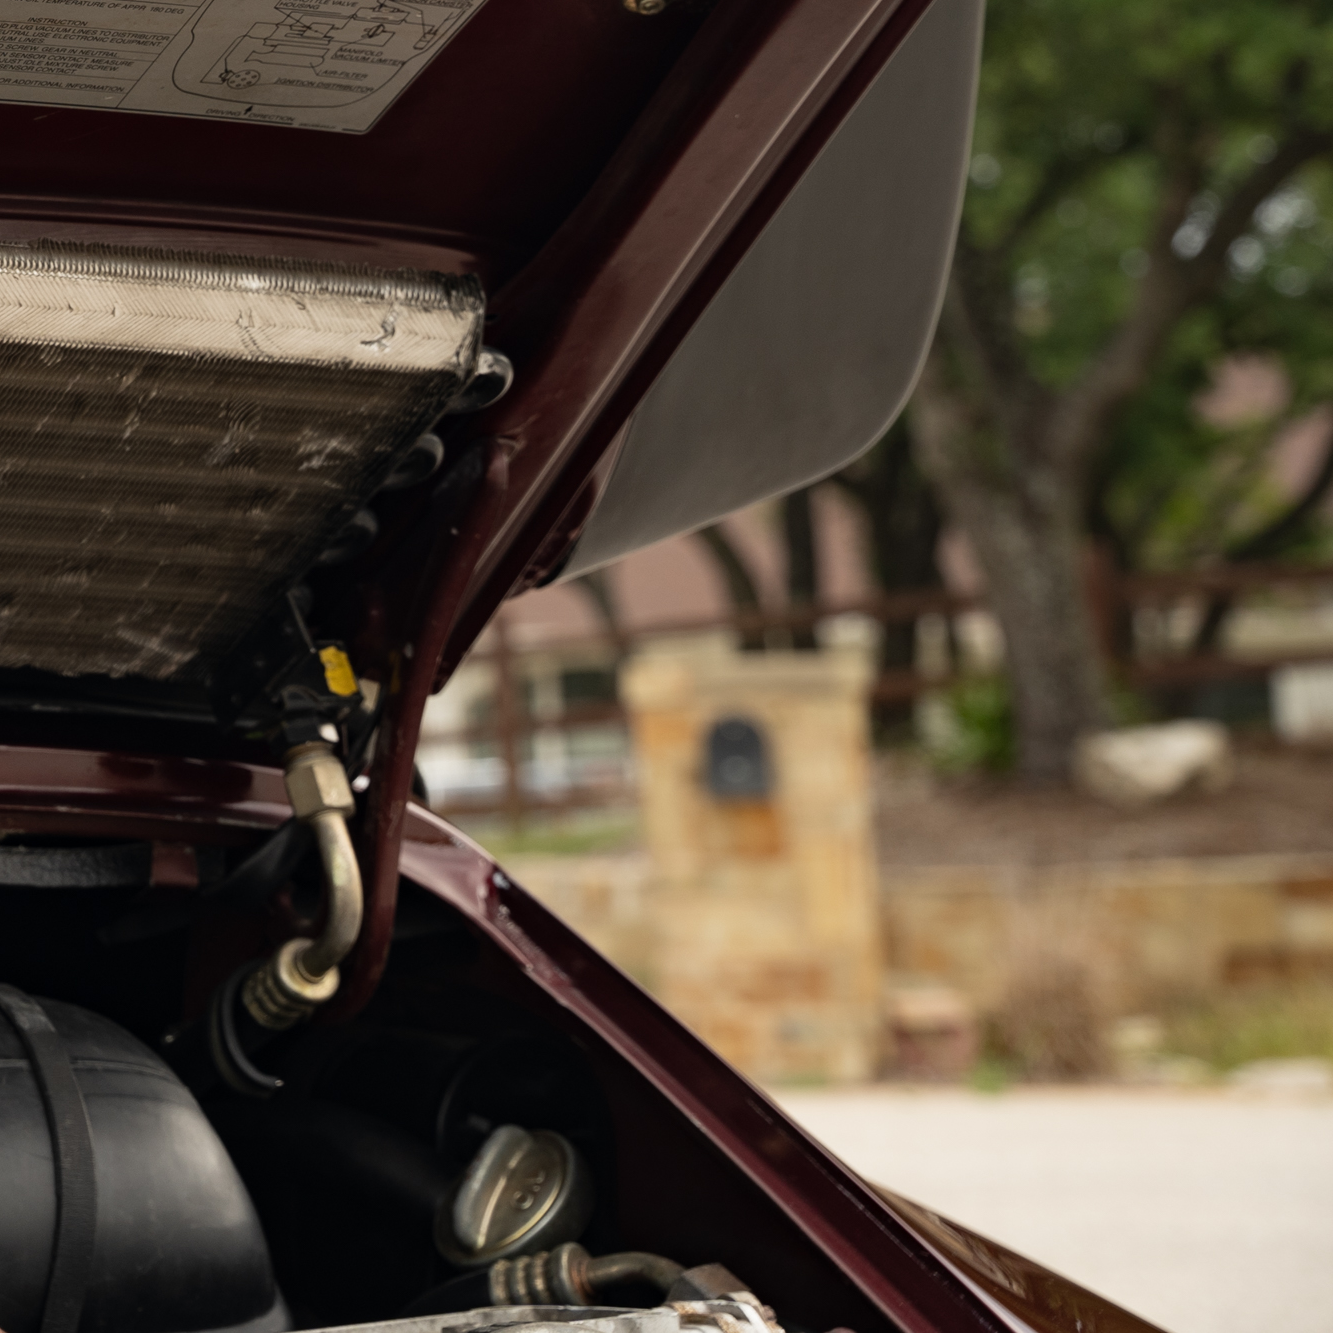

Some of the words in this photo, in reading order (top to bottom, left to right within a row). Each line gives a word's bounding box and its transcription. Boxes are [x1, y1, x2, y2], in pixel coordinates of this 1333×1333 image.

[26, 17, 89, 26] INSTRUCTION
[33, 25, 76, 33] VACUUM
[111, 31, 171, 41] DISTRIBUTOR
[51, 33, 109, 42] ELECTRONIC
[8, 52, 47, 60] SENSOR
[89, 58, 135, 66] MEASURE
[43, 61, 85, 69] MIXTURE
[11, 78, 63, 87] ADDITIONAL
[64, 82, 125, 91] INFORMATION
